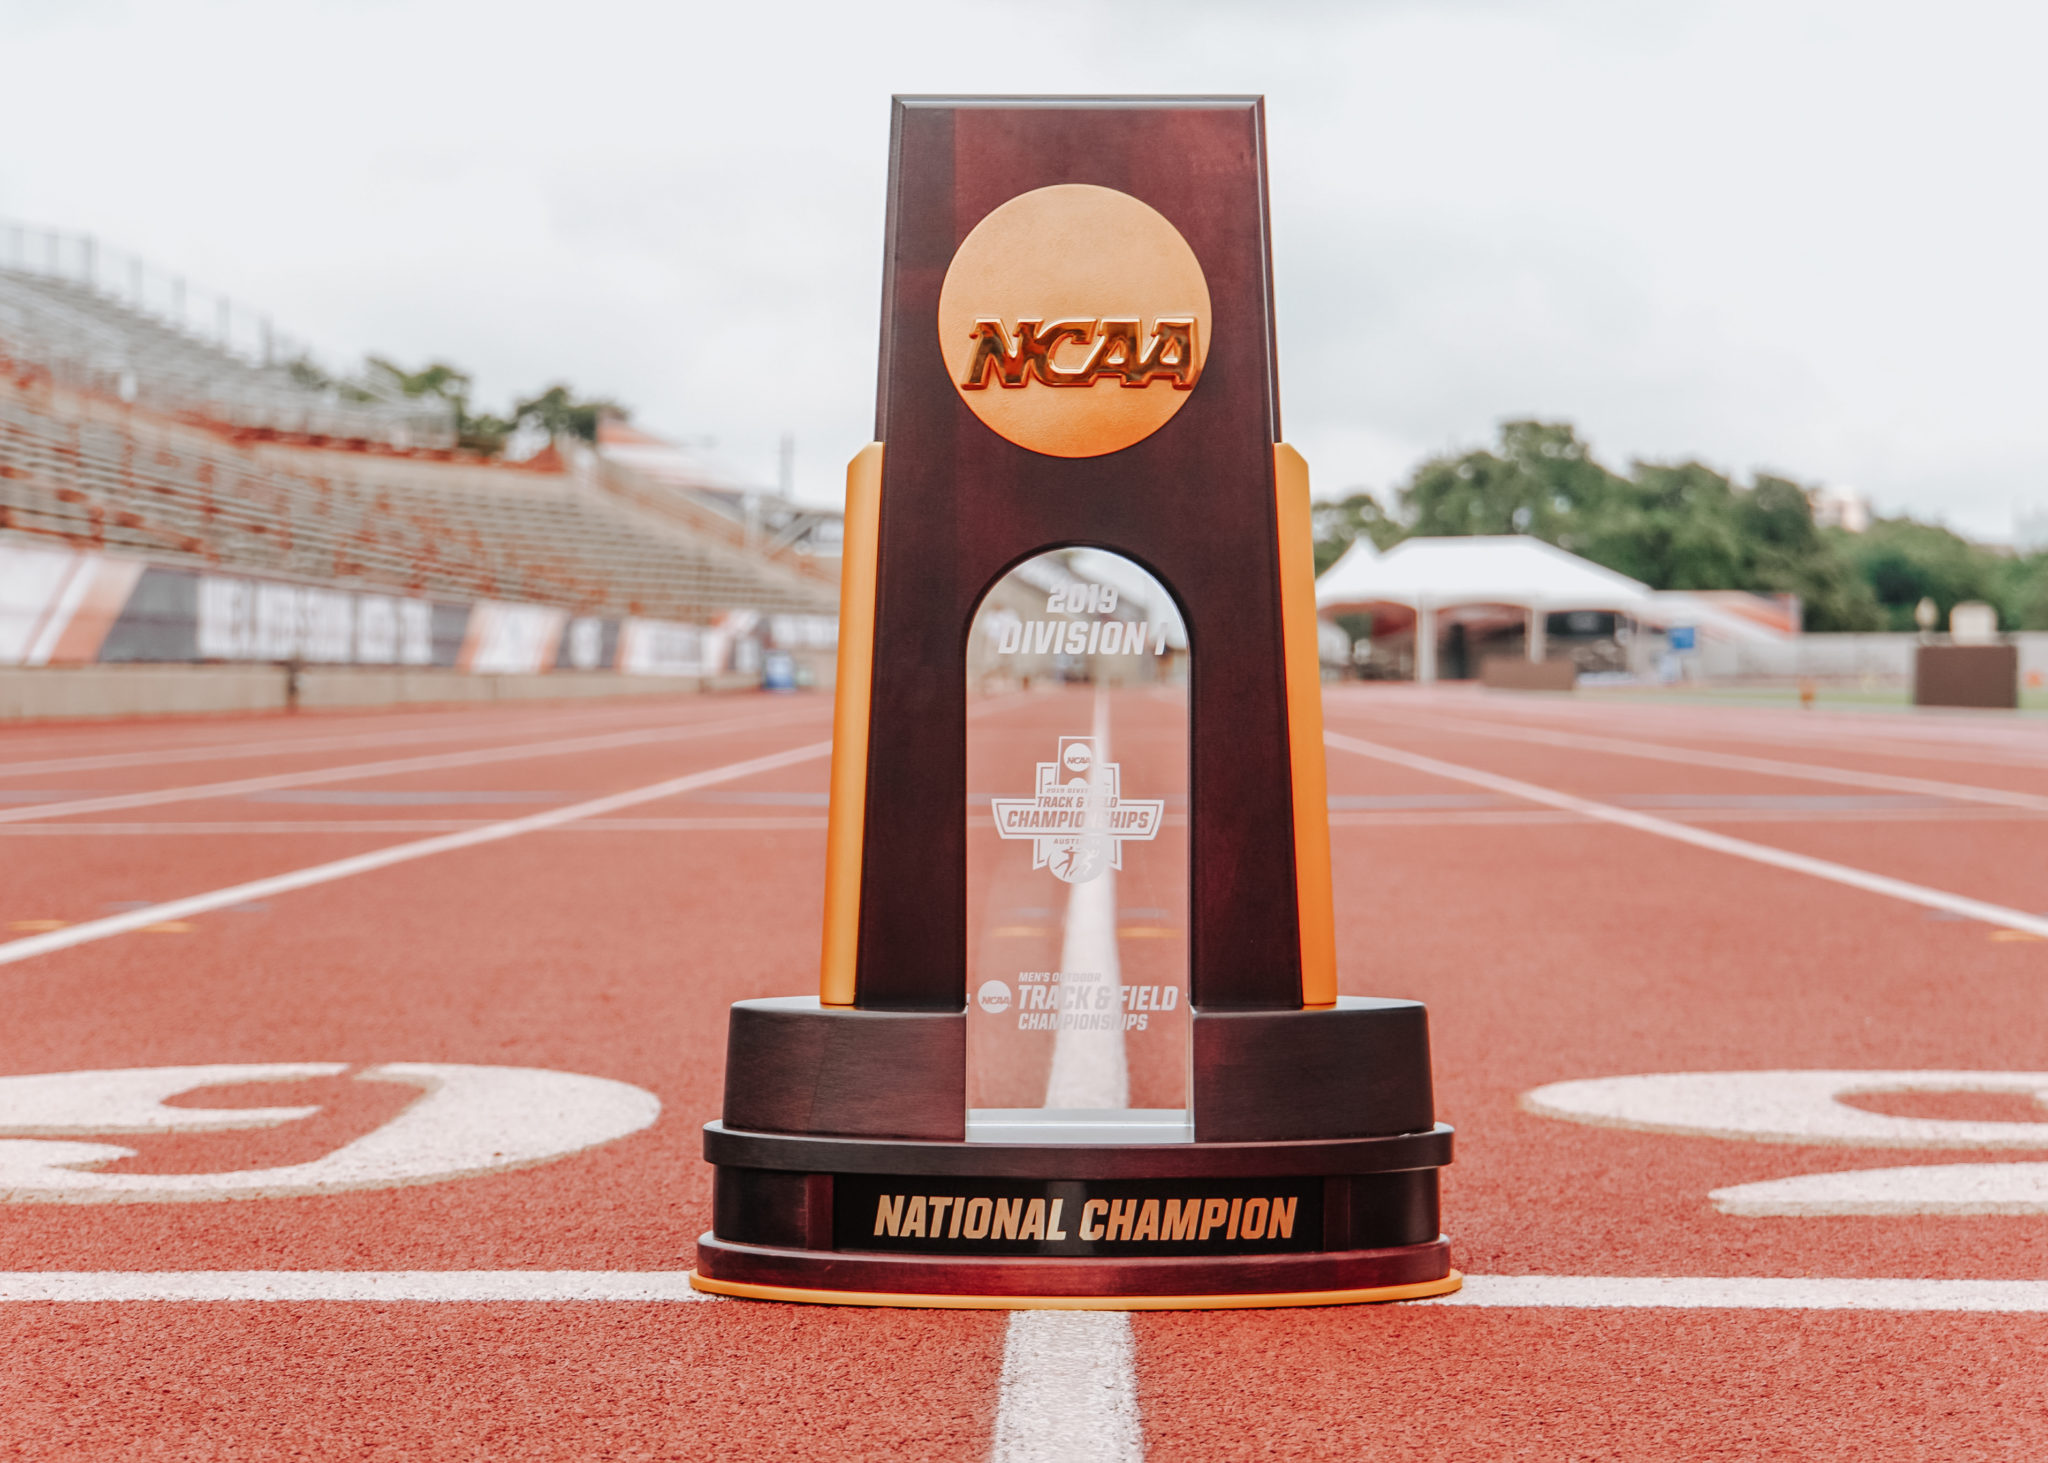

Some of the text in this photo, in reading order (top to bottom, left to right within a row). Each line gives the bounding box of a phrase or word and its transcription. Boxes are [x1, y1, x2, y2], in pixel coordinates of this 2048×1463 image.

[961, 316, 1199, 390] NCAA
[1046, 583, 1118, 614] 2019
[998, 620, 1168, 656] DIVISION I
[1037, 796, 1073, 808] TRACK
[1076, 796, 1084, 808] &
[1006, 810, 1150, 829] CHAMPIOHIPS
[1018, 972, 1050, 982] MEN'S
[1018, 984, 1179, 1011] TRACK & FIELD
[1018, 1013, 1149, 1031] CHAMPIONSHIPS
[873, 1195, 1298, 1241] NATIONAL CHAMPION
